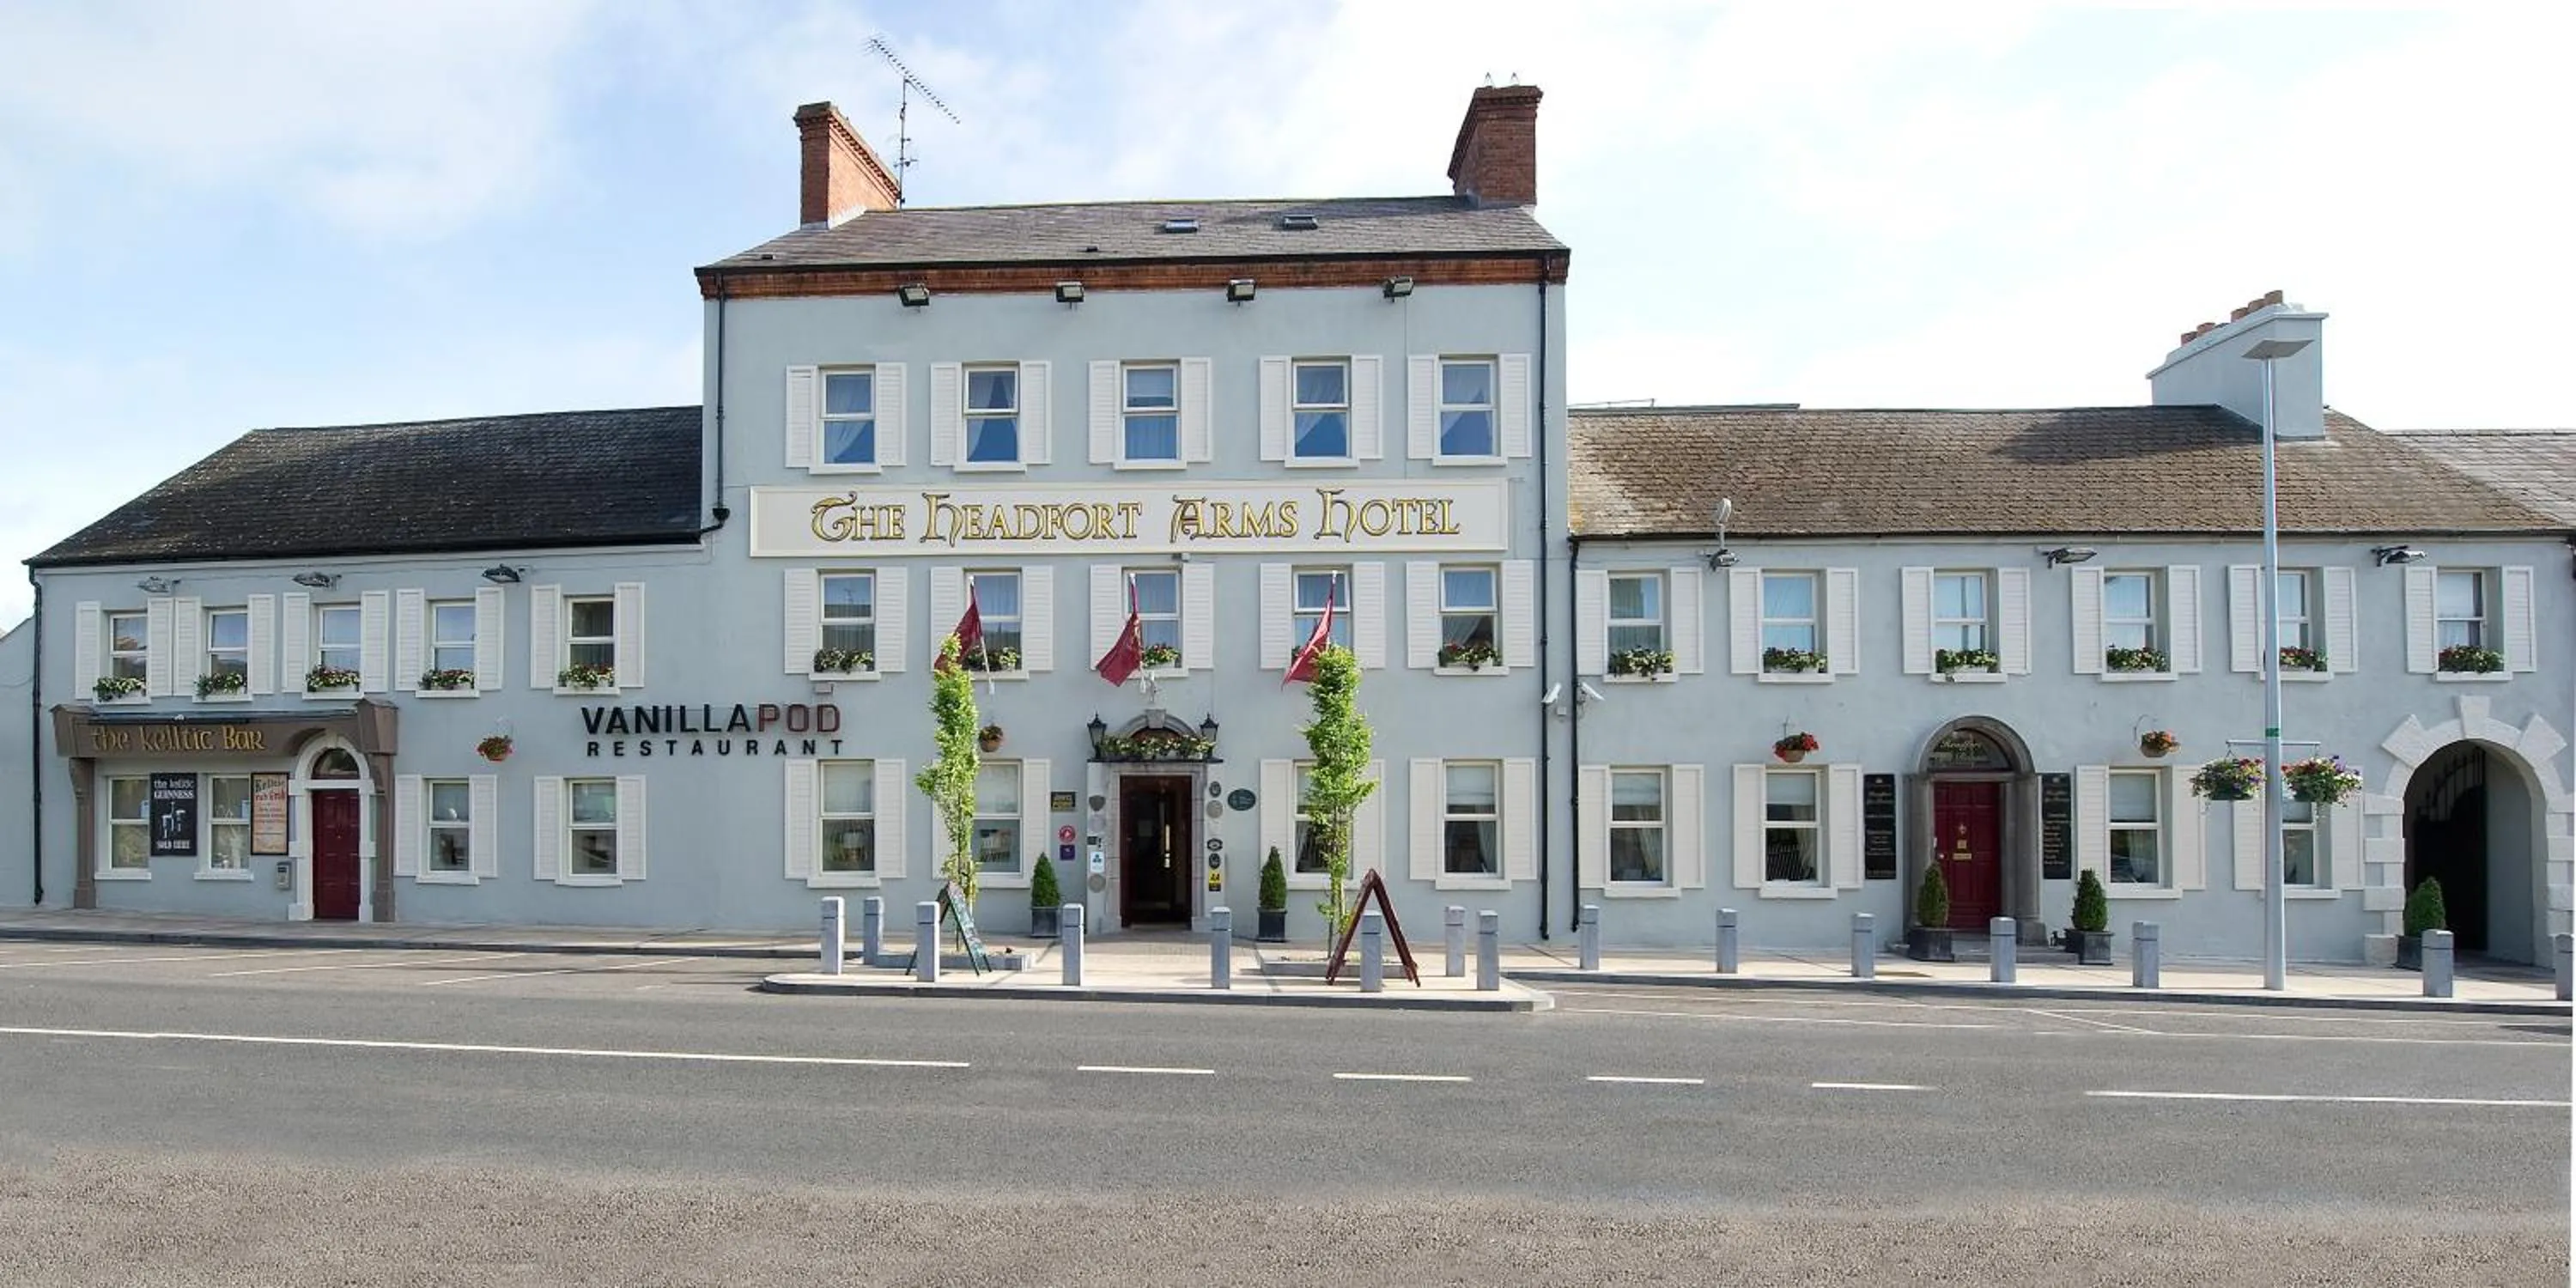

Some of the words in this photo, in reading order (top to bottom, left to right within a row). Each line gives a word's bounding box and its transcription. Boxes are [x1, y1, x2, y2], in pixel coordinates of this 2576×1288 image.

[91, 726, 129, 751] the
[586, 739, 843, 756] RESTAURANT
[154, 789, 194, 799] GUINNESS
